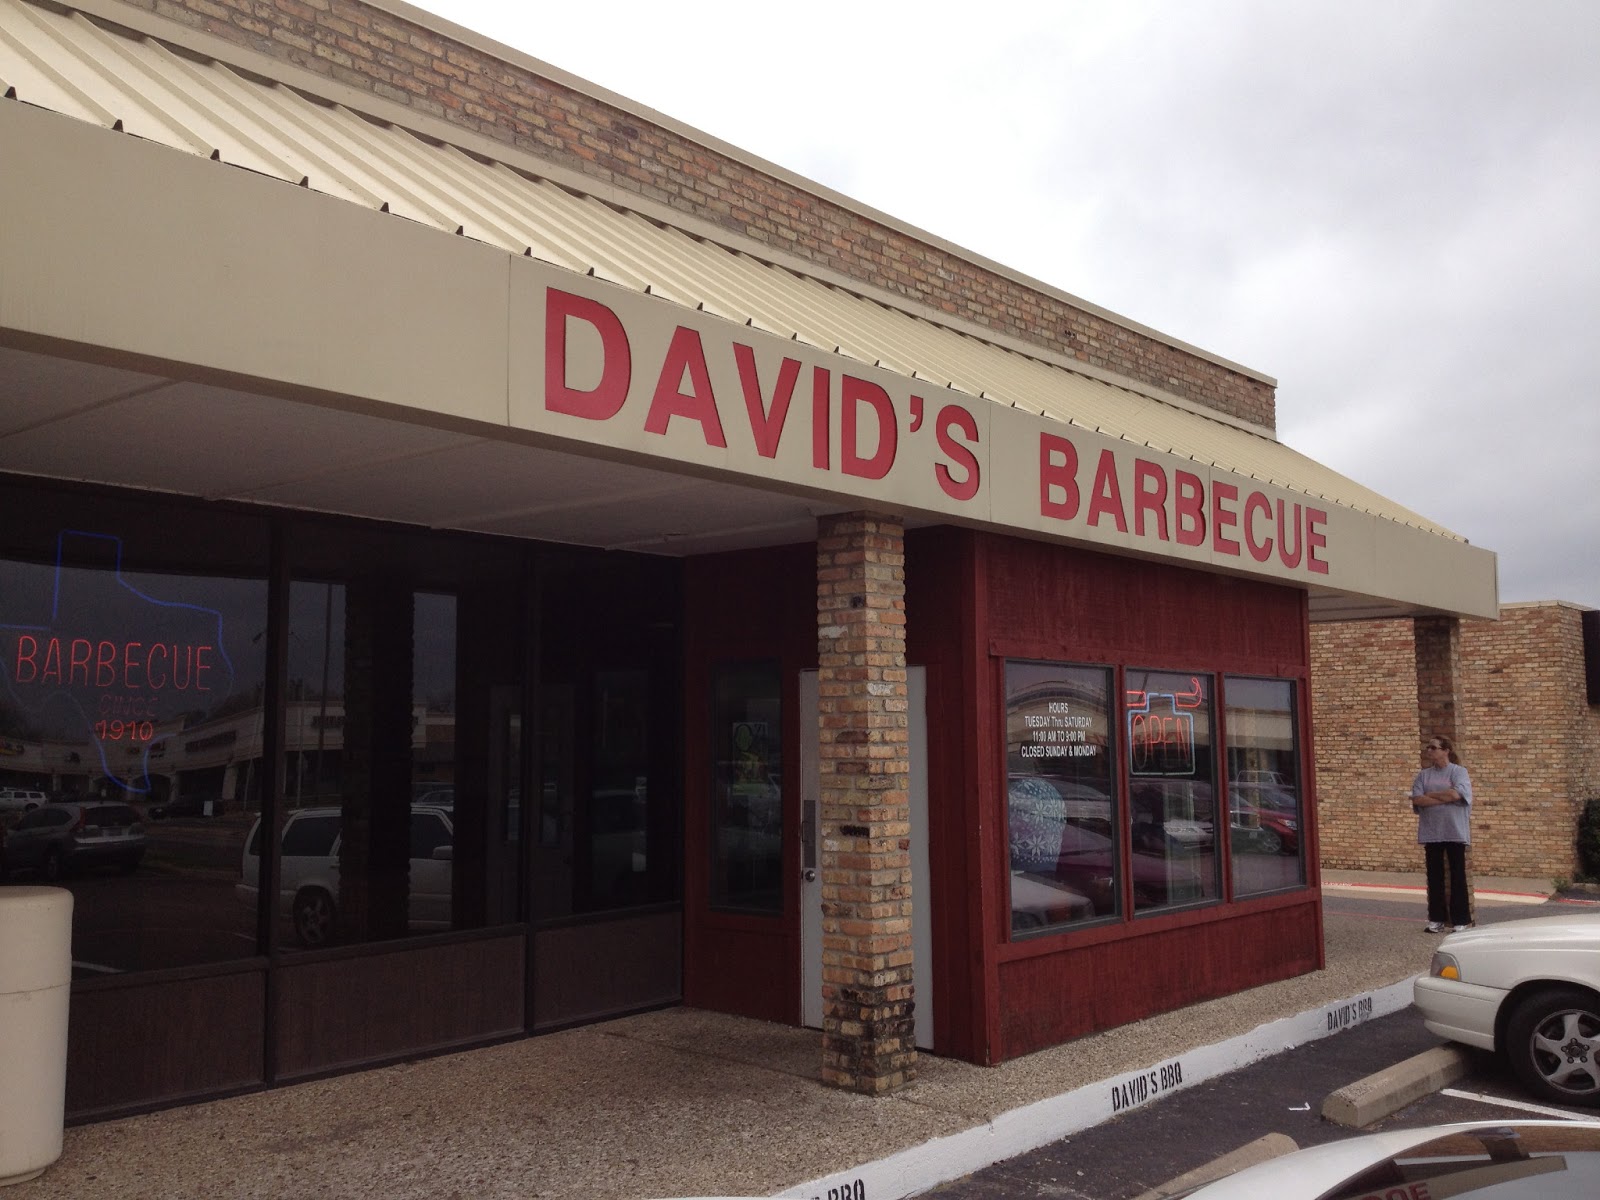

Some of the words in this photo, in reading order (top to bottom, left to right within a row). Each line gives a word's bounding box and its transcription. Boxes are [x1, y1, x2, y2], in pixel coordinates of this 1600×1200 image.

[545, 286, 980, 501] DAVID'S
[1040, 432, 1329, 575] BARBECUE
[15, 635, 212, 691] BARBECUE
[1025, 716, 1050, 728] TUESDAY
[1051, 716, 1064, 728] Thru
[1064, 716, 1092, 728] SATURDAY
[1048, 702, 1069, 714] HOURS
[95, 719, 153, 741] 1910
[1032, 731, 1046, 742] 11:00
[1047, 731, 1057, 742] AM
[1057, 731, 1065, 742] TO
[1077, 731, 1086, 742] PM
[1132, 715, 1191, 769] OPEN
[1021, 745, 1045, 758] CLOSED
[1045, 745, 1068, 758] SUNDAY
[1073, 745, 1097, 757] MONDAY
[1327, 1003, 1357, 1031] DAVID'S
[1358, 996, 1373, 1019] BBQ
[1112, 1071, 1158, 1112] DAVID'S
[1160, 1061, 1183, 1090] BBQ
